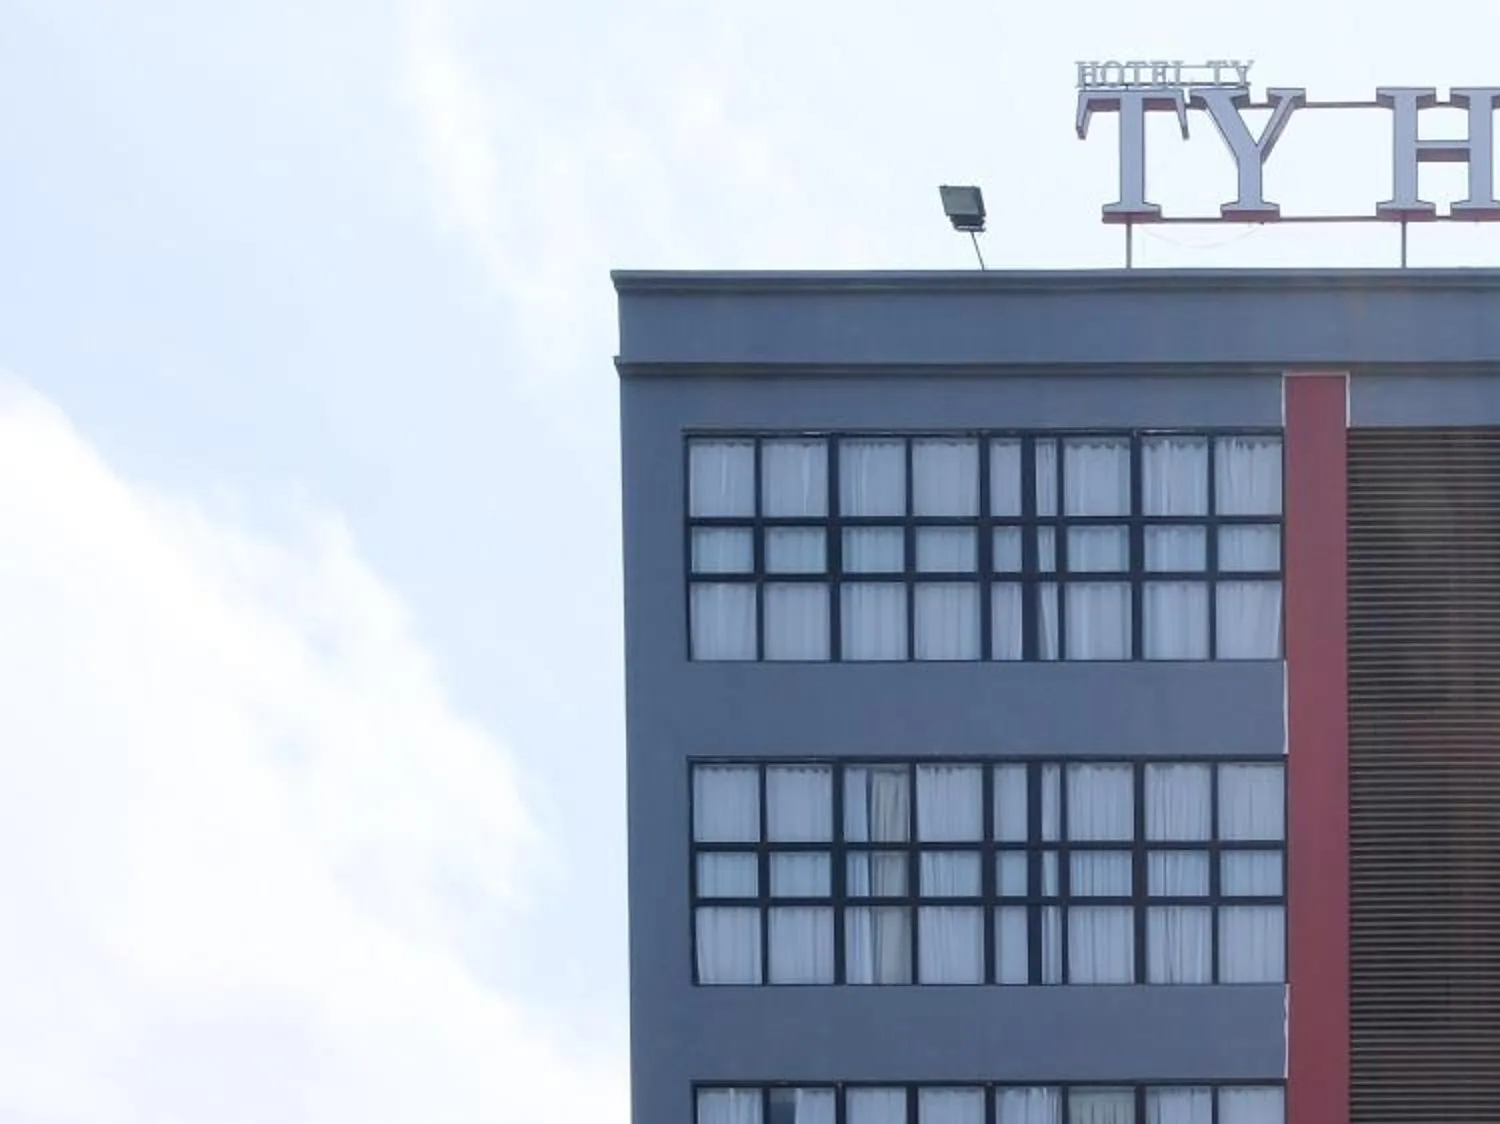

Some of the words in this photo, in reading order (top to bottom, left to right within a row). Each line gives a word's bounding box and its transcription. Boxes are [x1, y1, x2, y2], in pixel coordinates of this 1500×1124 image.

[1075, 60, 1184, 88] HOTEL
[1206, 60, 1254, 88] TY
[1075, 87, 1306, 223] TY
